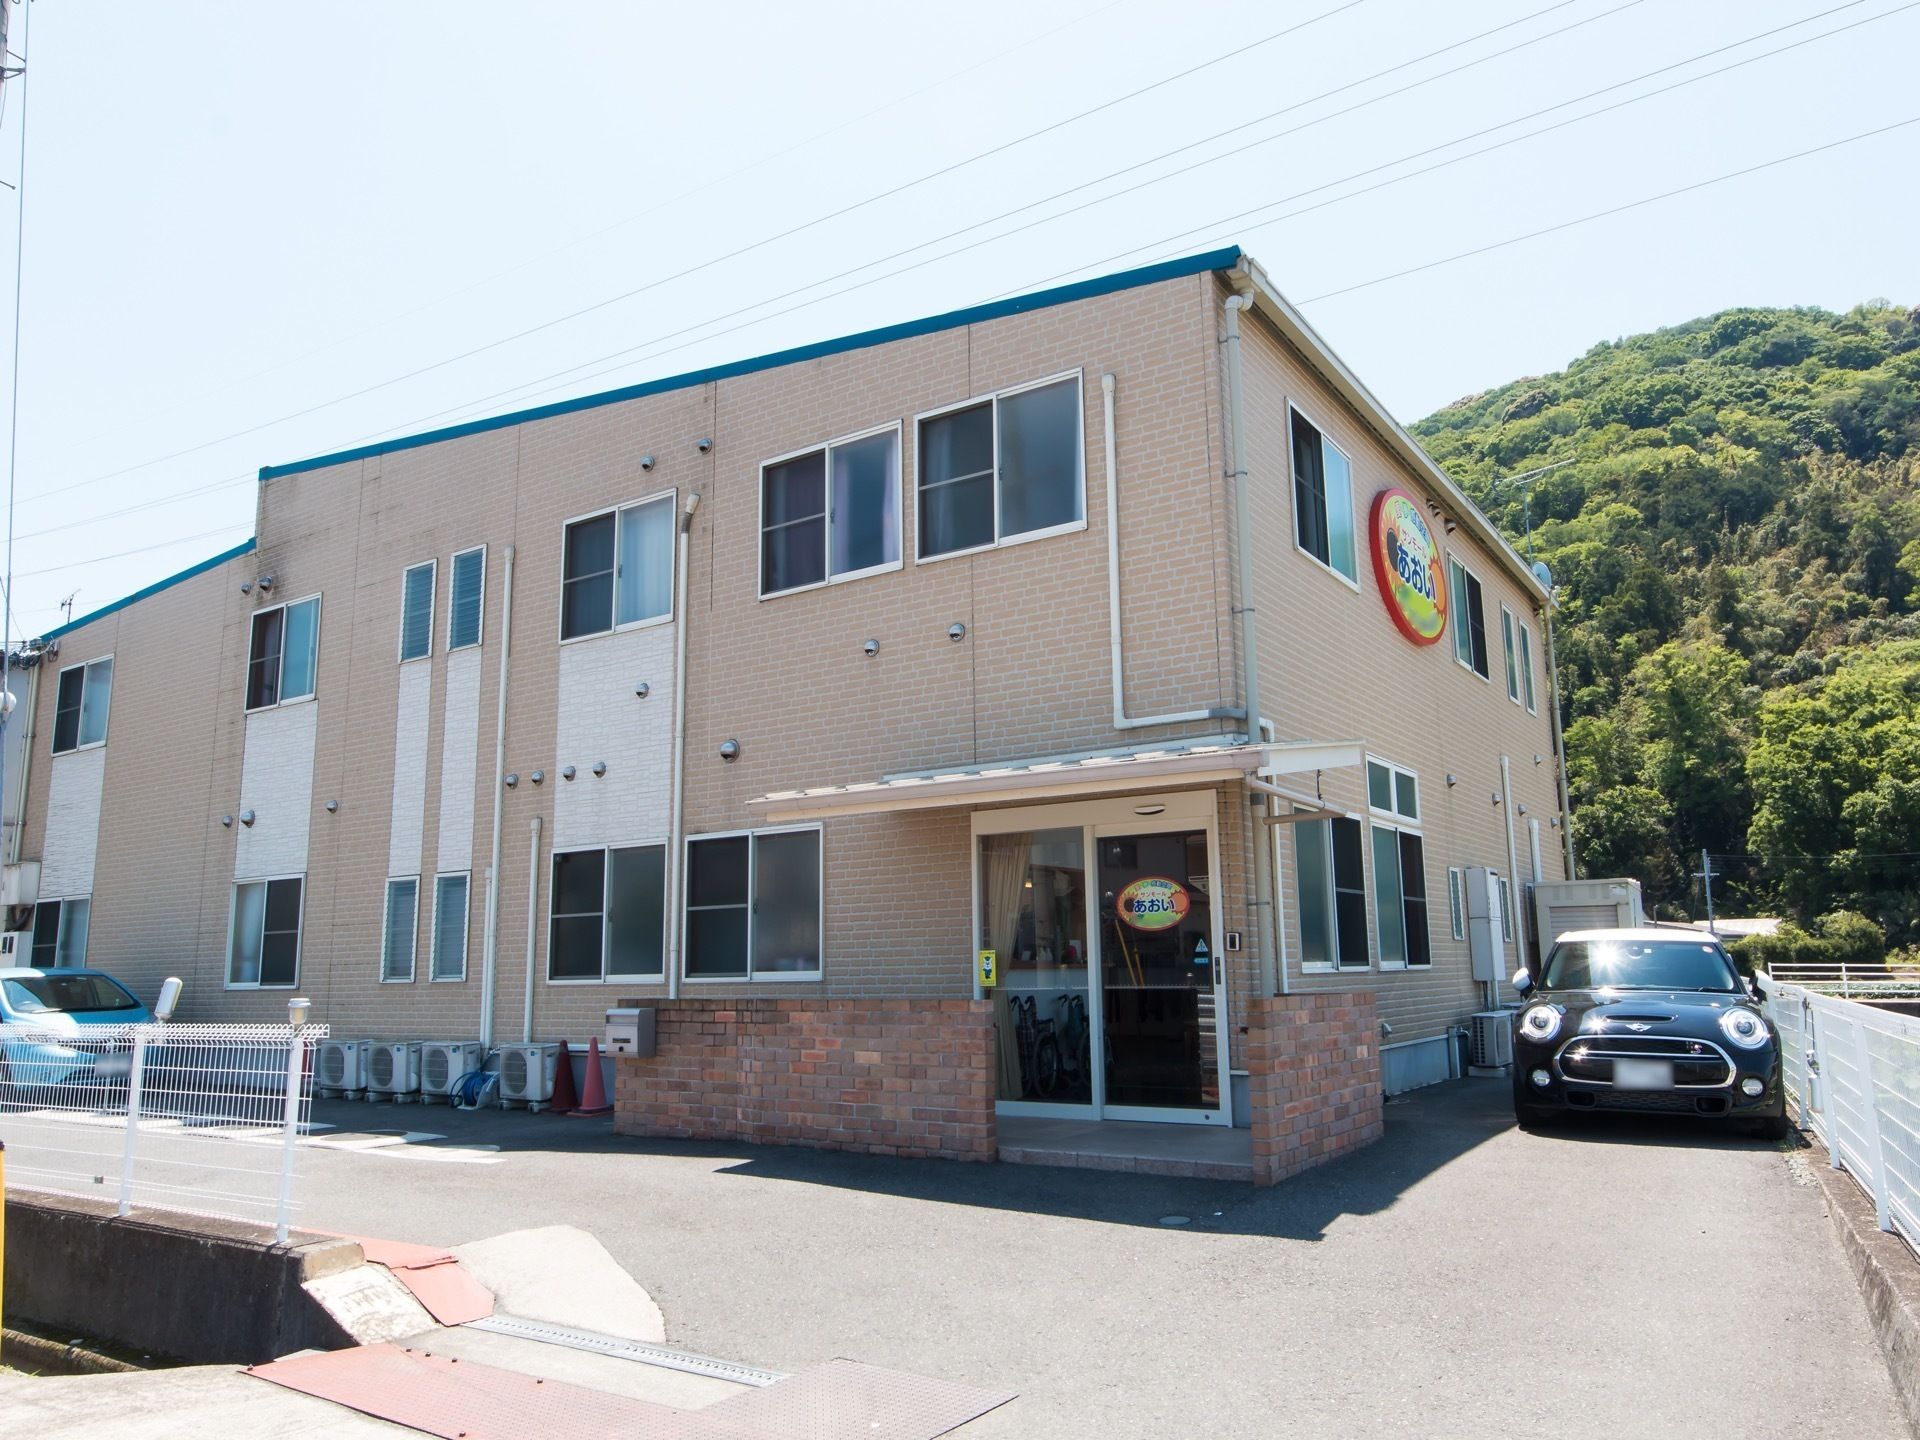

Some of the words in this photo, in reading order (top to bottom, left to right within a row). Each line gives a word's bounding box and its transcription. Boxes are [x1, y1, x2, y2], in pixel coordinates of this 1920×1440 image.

[1397, 543, 1436, 600] あおい
[1134, 899, 1174, 913] あおい
